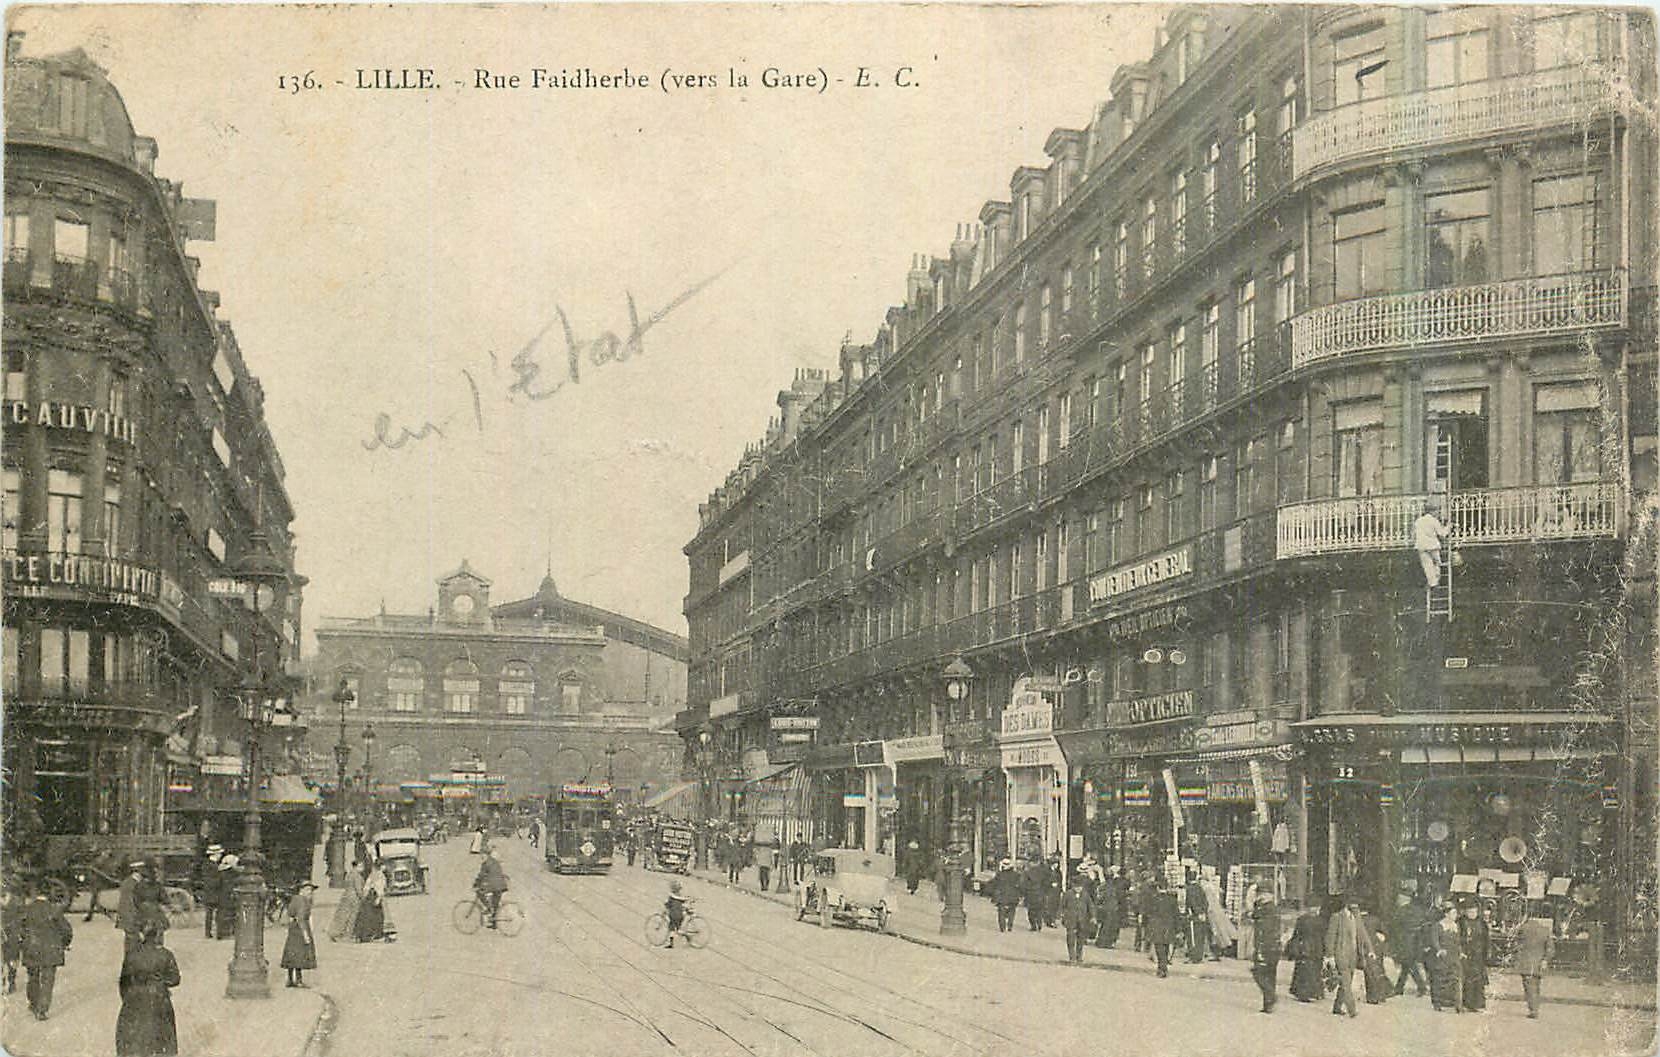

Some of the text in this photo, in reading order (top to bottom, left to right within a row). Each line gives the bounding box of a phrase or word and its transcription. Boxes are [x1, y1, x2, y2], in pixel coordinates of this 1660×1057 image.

[1128, 690, 1193, 722] OPTICIEN
[1419, 726, 1510, 742] MUSIQUE
[1339, 767, 1354, 777] 12
